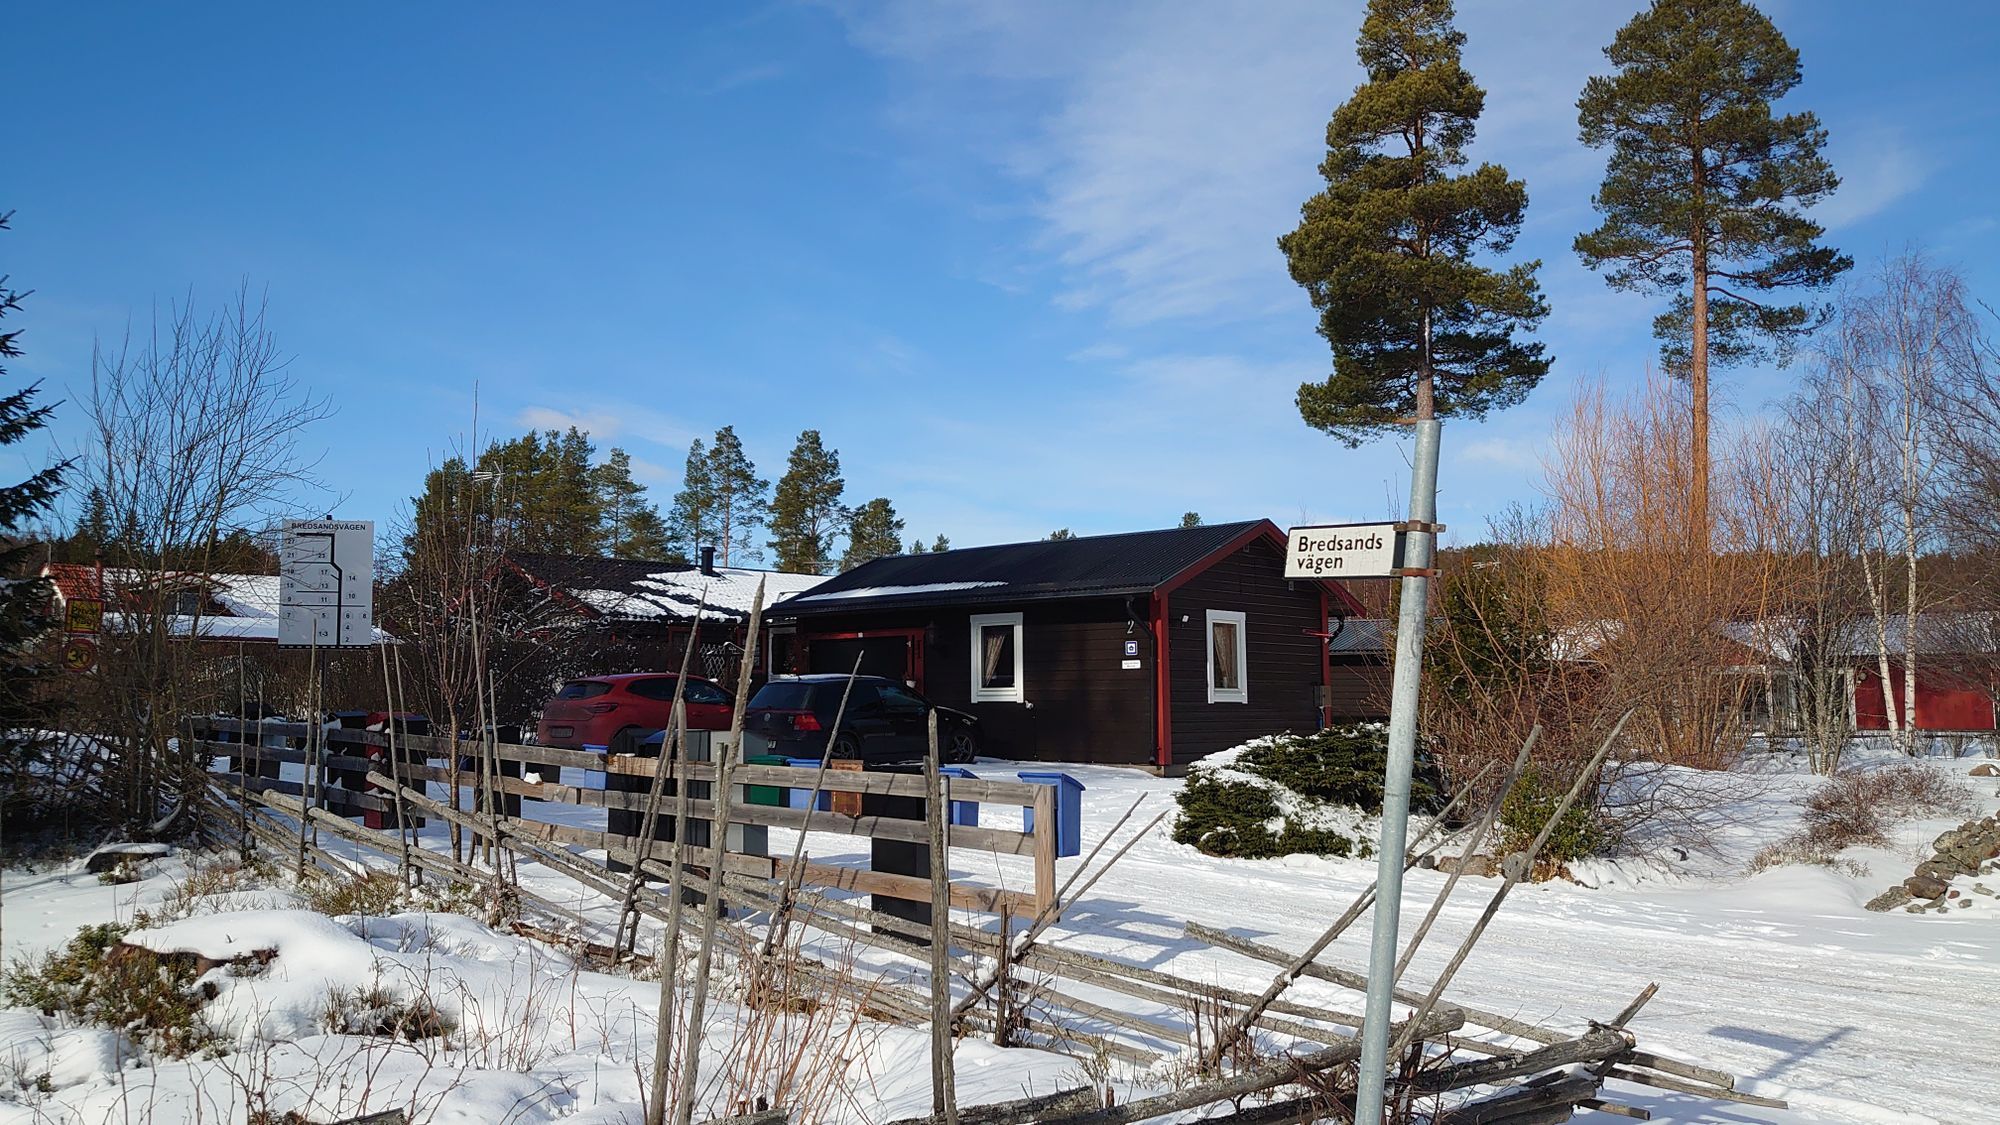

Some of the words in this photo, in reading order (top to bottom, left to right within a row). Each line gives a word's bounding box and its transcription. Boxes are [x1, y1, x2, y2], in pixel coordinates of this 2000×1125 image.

[291, 522, 366, 531] BREDSANDSVÄGEN
[1297, 532, 1383, 552] Bredsands
[1297, 554, 1343, 575] vägen
[1126, 619, 1135, 634] 2
